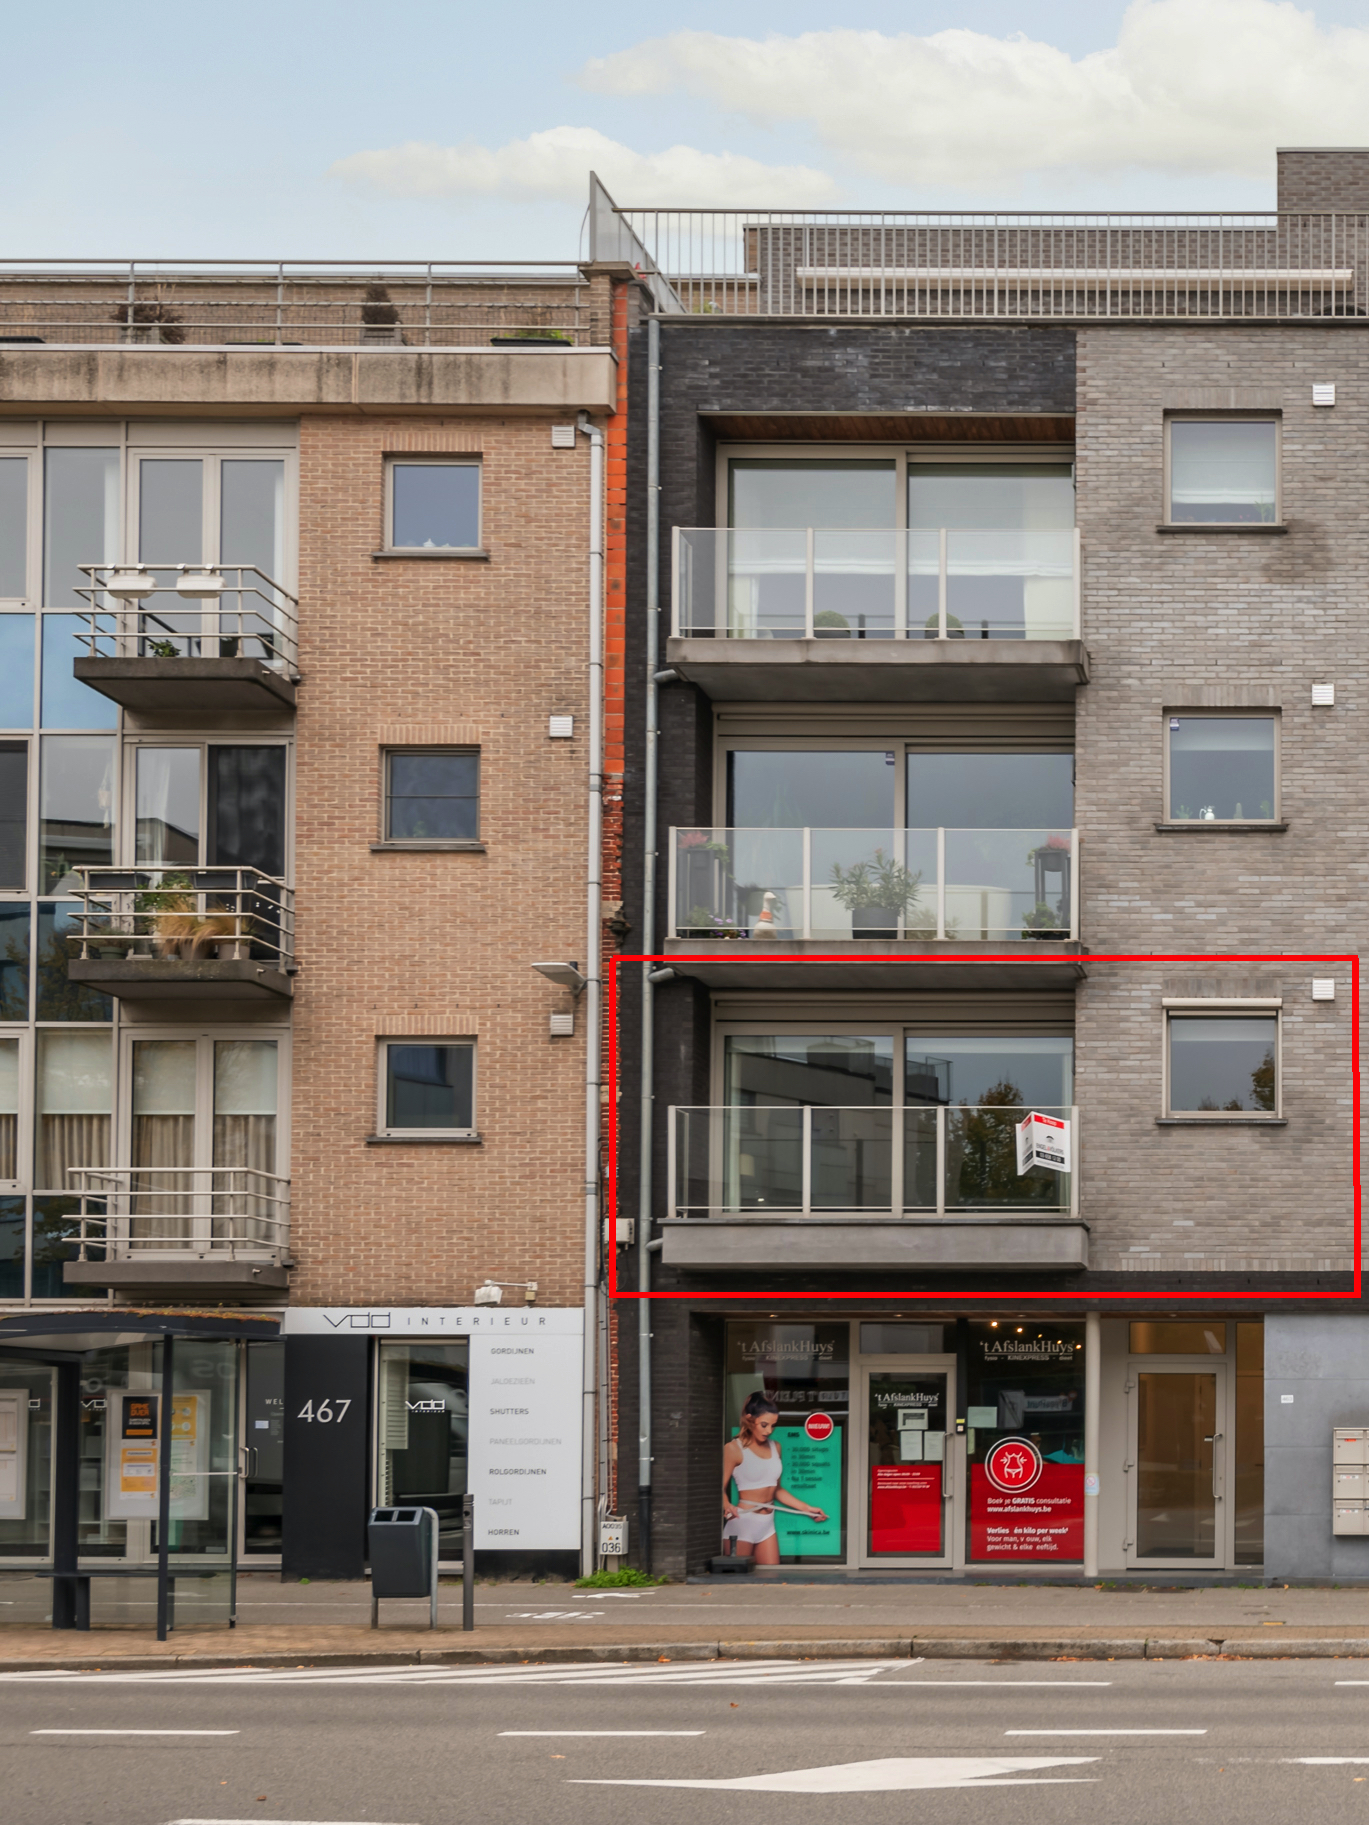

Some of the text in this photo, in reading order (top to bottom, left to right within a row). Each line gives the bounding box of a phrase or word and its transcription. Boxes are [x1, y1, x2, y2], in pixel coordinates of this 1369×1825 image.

[407, 1316, 547, 1326] INTERIEUR
[297, 1399, 351, 1422] 467
[602, 1542, 621, 1553] 036
